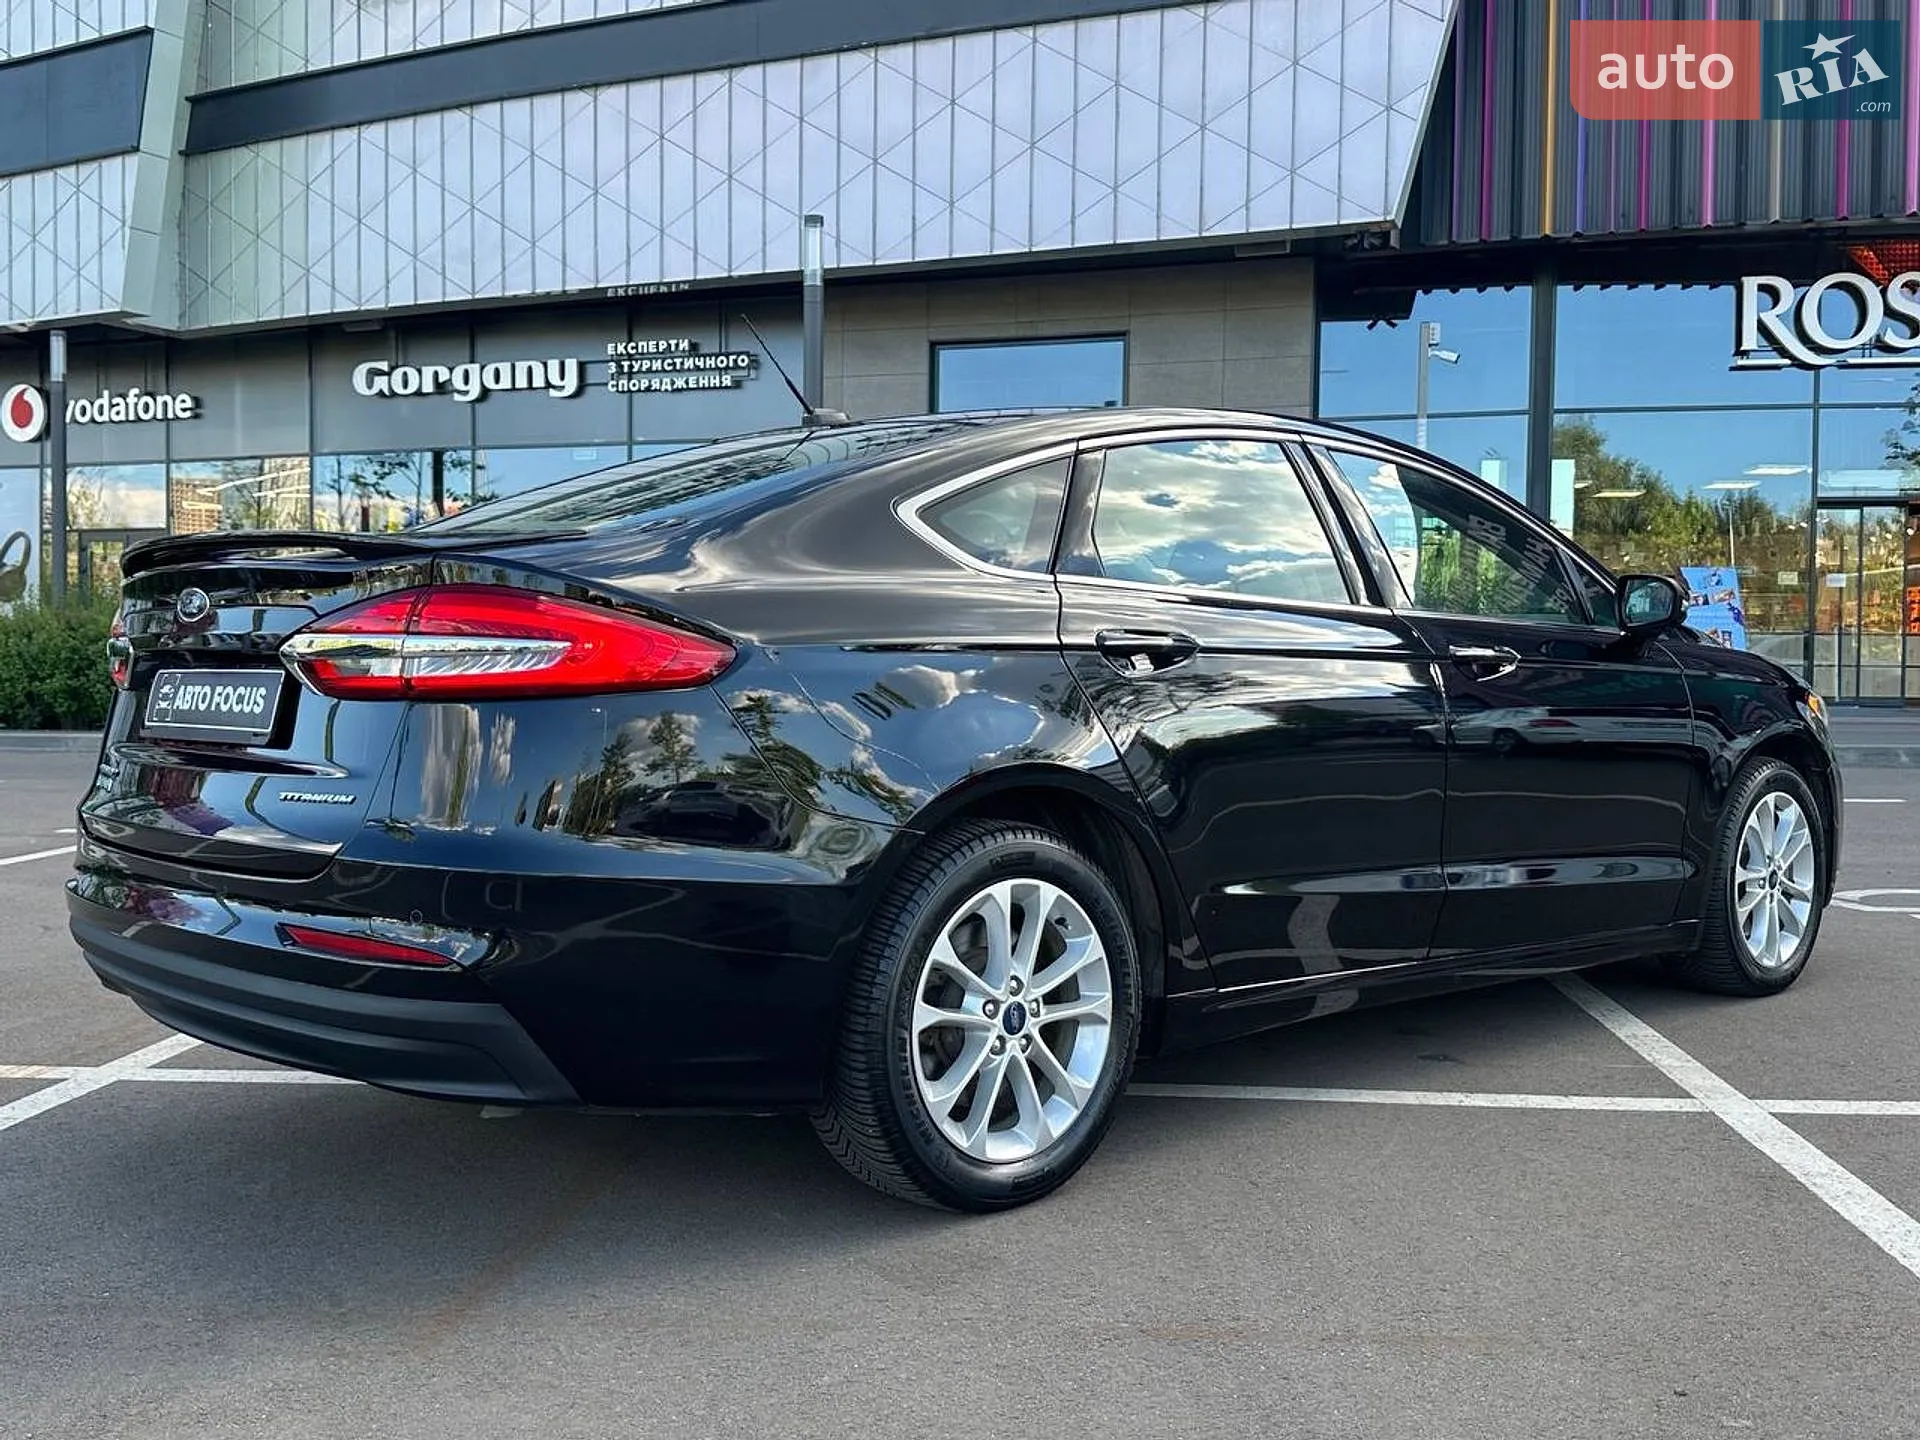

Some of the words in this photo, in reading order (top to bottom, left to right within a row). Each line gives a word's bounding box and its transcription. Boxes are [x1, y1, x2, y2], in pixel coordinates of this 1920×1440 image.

[607, 338, 690, 355] ЕКСПЕРТИ
[607, 361, 617, 373] З
[621, 355, 749, 373] ТУРИСТИЧНОГО
[352, 358, 579, 402] Gorgany
[607, 375, 732, 392] СПОРЯДЖЕННЯ
[211, 685, 267, 714] FOCUS
[279, 791, 355, 803] TITANIUM
